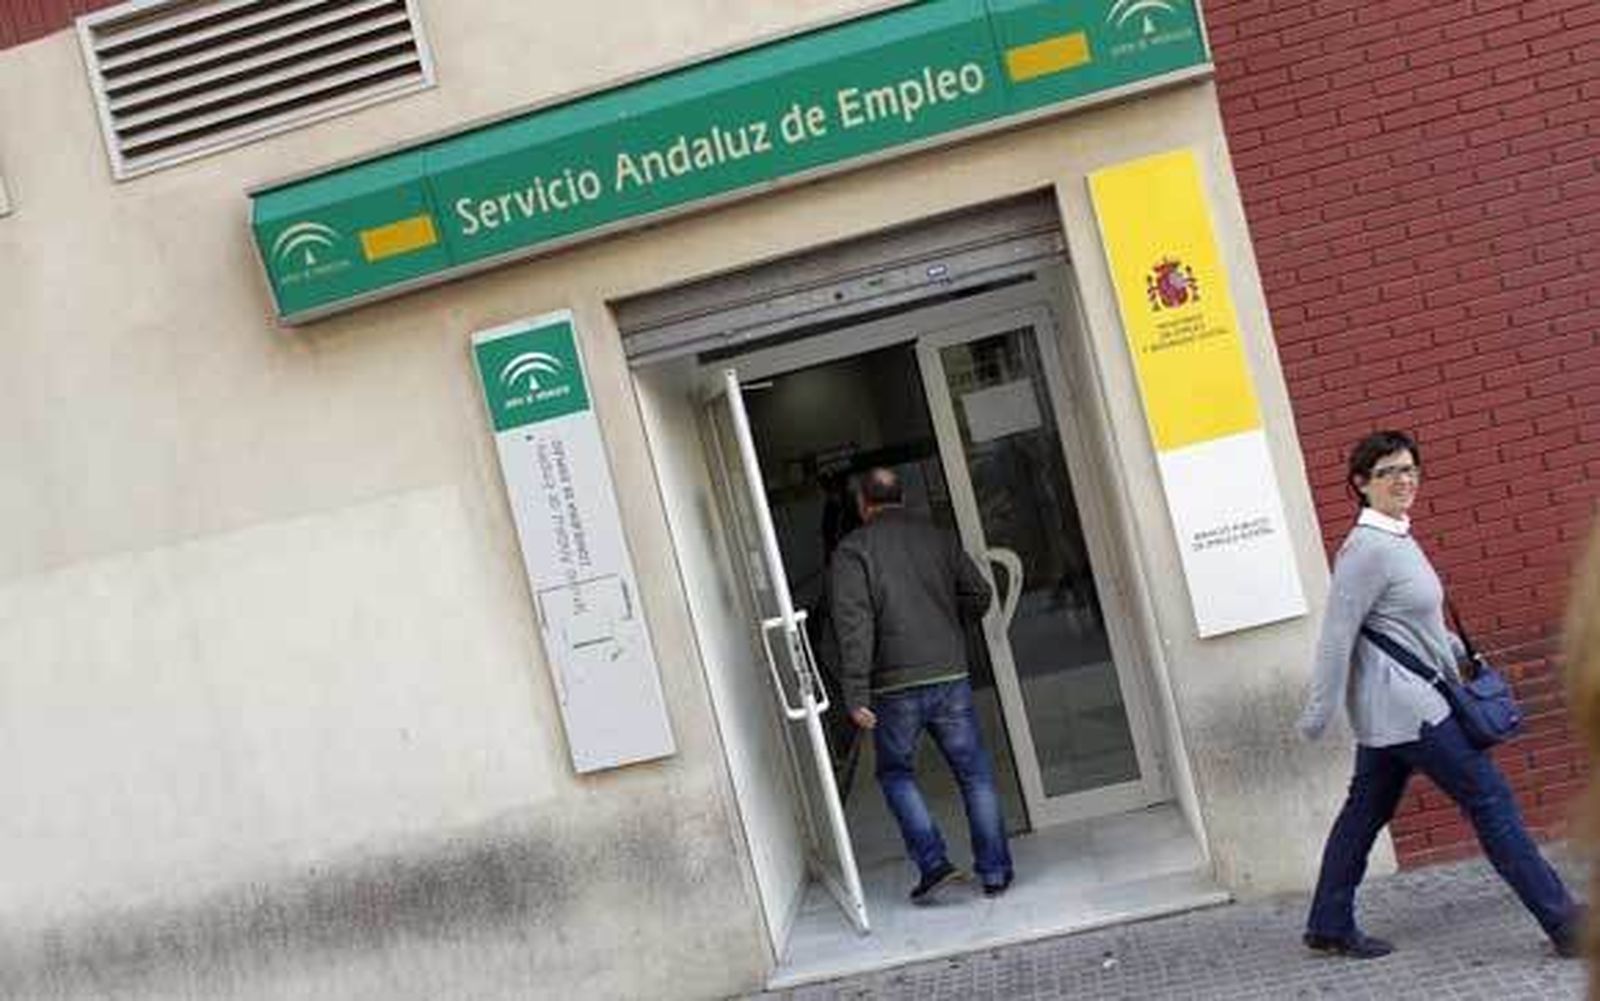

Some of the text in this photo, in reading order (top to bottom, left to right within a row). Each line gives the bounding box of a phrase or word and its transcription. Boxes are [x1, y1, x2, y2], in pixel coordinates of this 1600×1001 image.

[455, 62, 984, 235] Servicio Andaluz de Empleo
